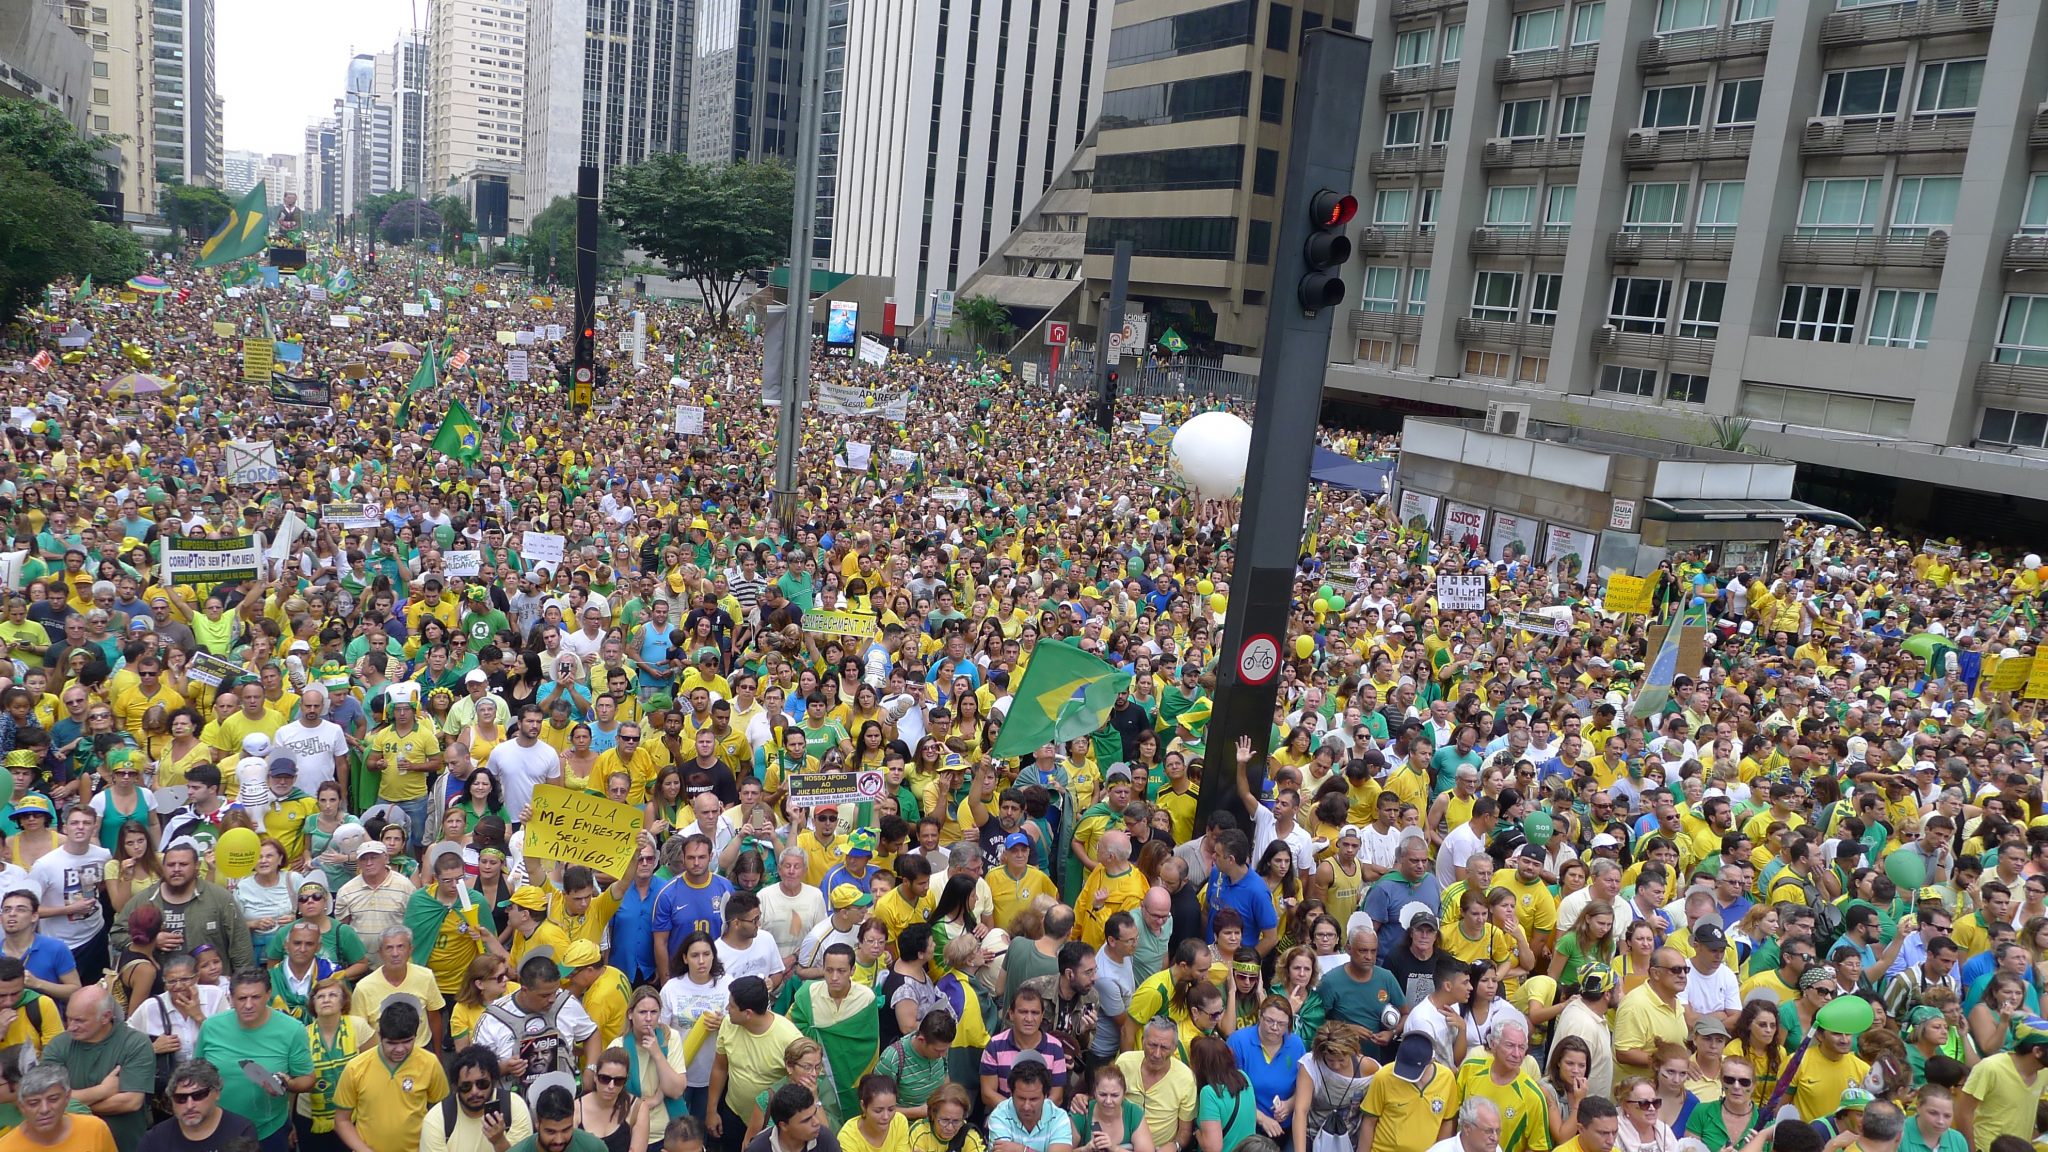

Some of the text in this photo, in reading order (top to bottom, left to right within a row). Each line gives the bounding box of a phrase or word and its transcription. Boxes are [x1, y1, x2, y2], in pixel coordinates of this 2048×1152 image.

[841, 399, 889, 410] desapreça
[1615, 505, 1632, 514] GUIA
[208, 556, 220, 567] SEM
[221, 553, 231, 567] PT
[231, 555, 240, 565] NO
[241, 553, 255, 565] MEIO
[1441, 576, 1482, 586] FORA
[1447, 587, 1485, 597] DILMA
[561, 793, 618, 823] LULA
[539, 810, 631, 845] ME EMPRESTA
[556, 830, 589, 845] SEUS
[532, 1037, 557, 1049] veja
